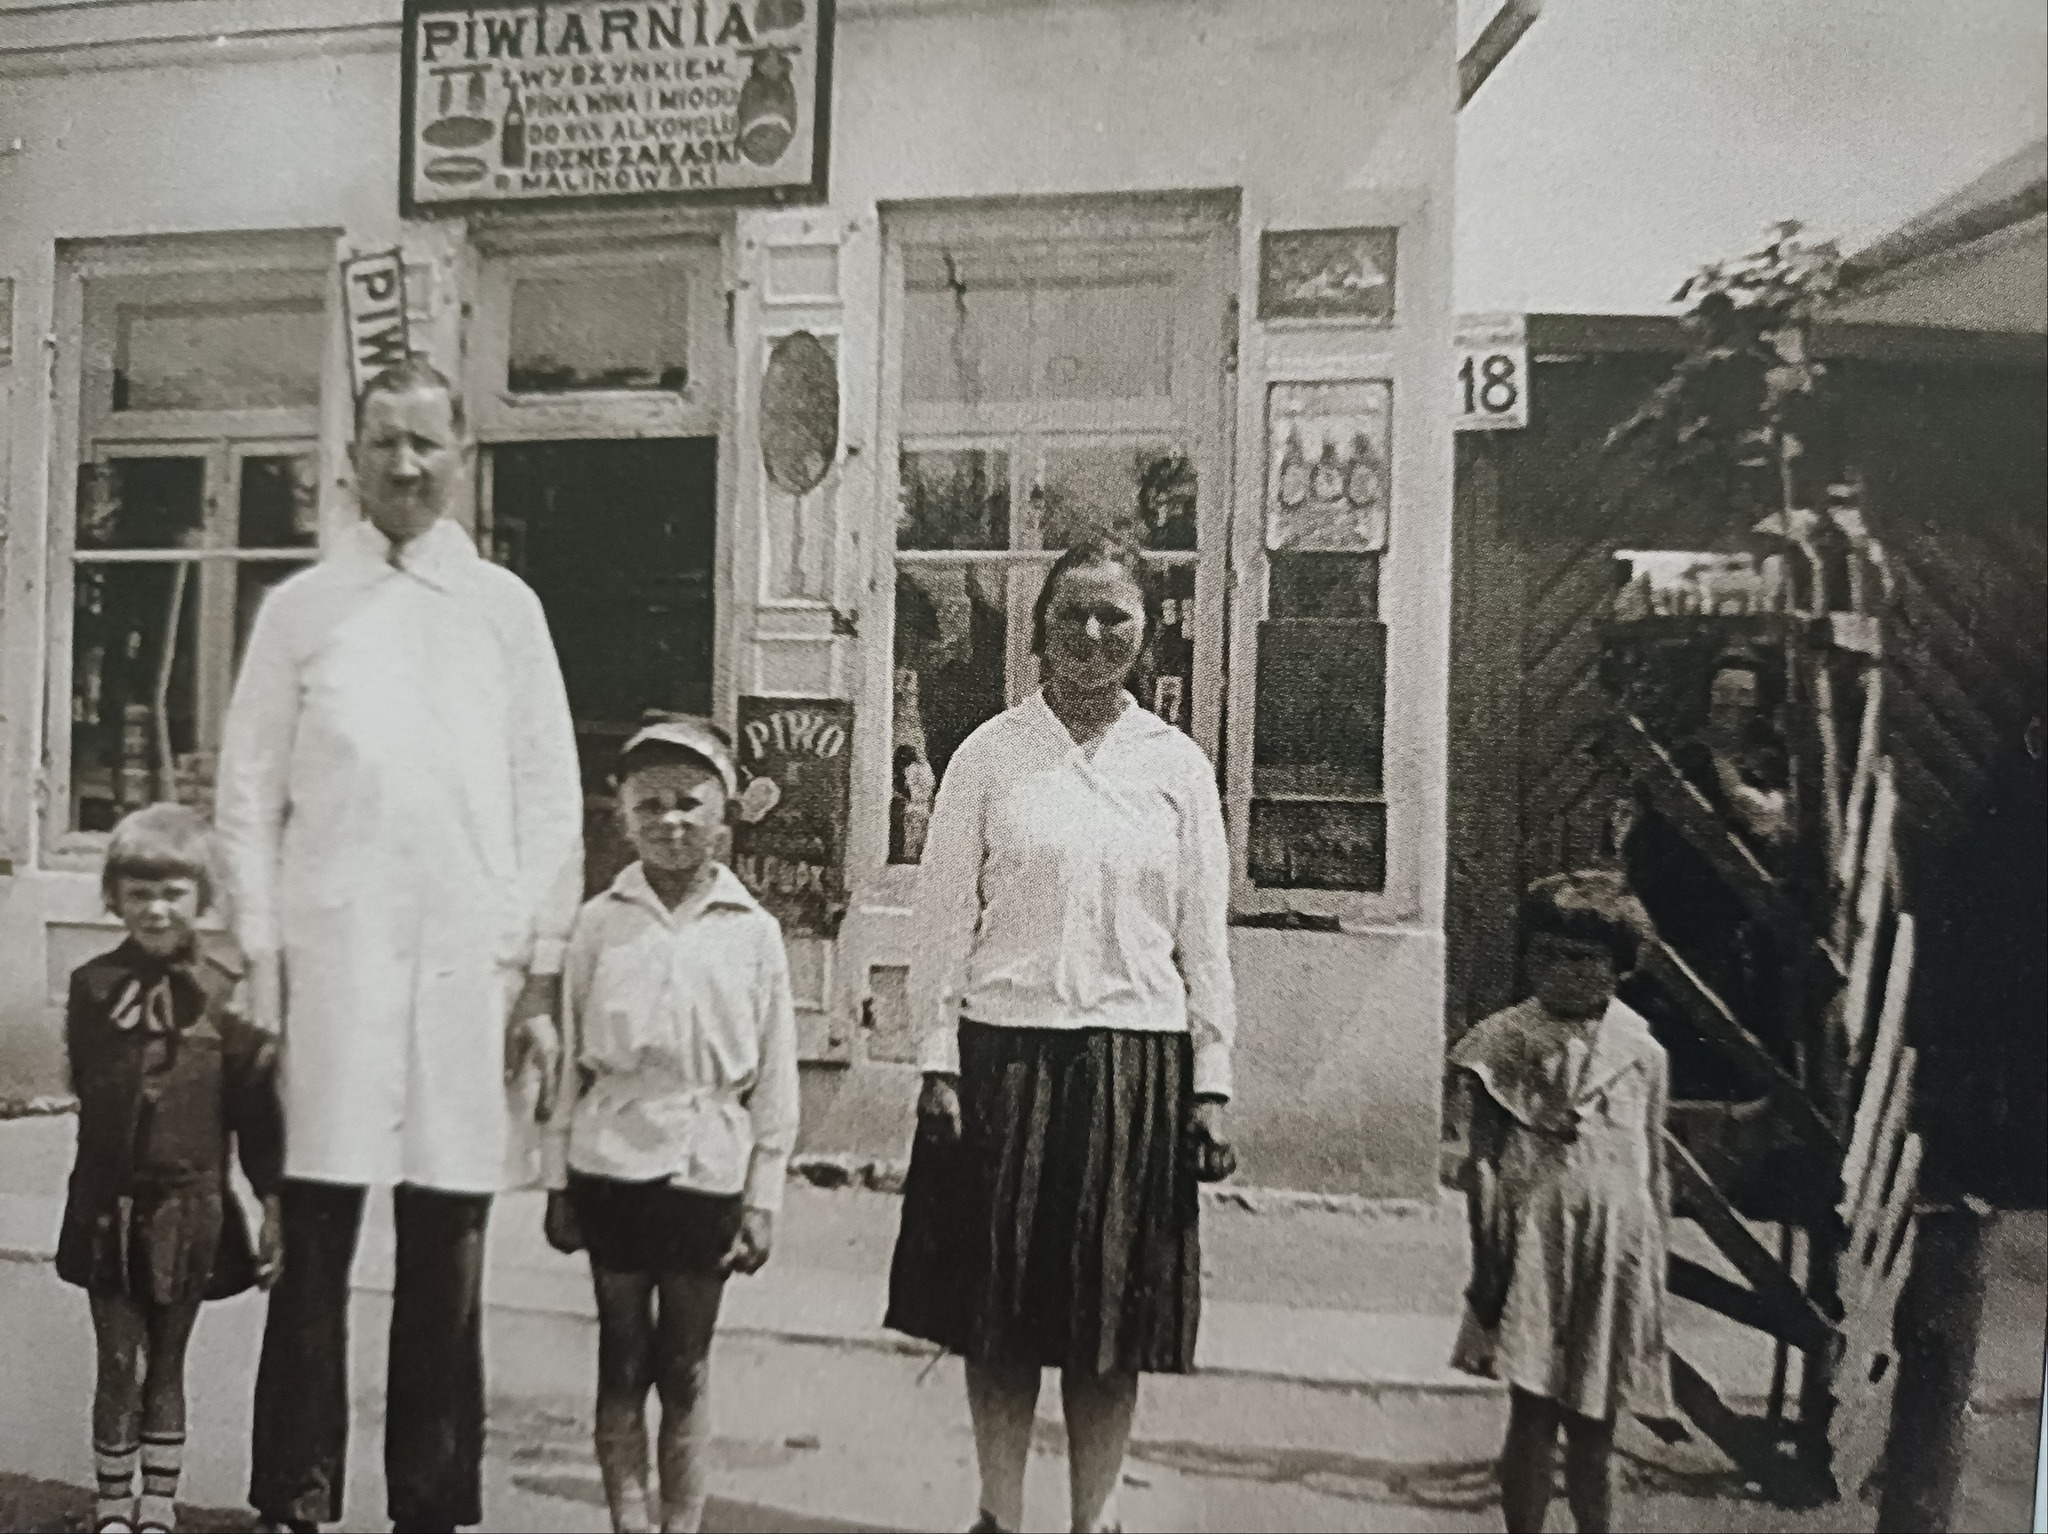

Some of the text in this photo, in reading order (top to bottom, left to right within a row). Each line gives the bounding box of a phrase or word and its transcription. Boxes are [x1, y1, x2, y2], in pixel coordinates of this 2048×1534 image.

[422, 3, 754, 61] PIWIARNIA
[1458, 354, 1518, 414] 18
[746, 711, 845, 759] PIWO
